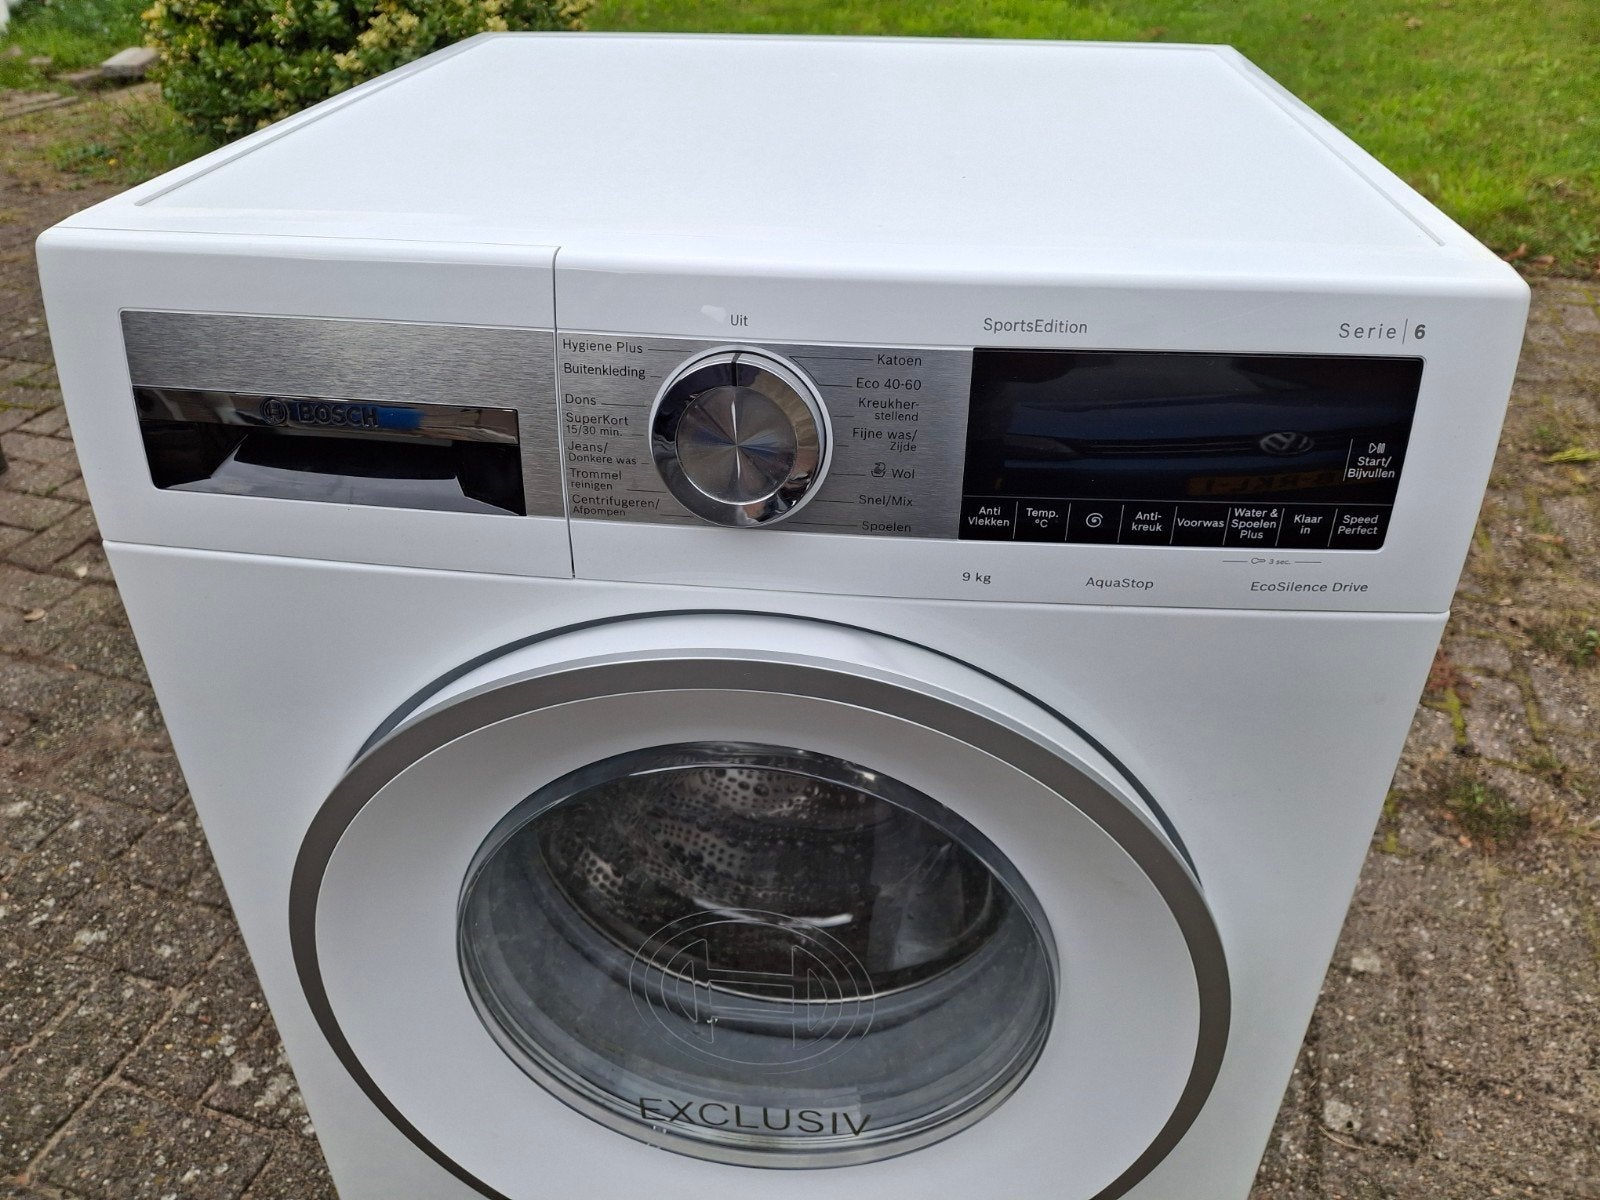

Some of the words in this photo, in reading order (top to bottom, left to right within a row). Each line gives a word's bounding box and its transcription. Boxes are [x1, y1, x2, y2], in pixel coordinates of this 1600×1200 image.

[730, 314, 749, 327] Uit
[983, 317, 1088, 334] SportsEdition
[1338, 322, 1397, 340] Serie
[1414, 323, 1426, 340] 6
[562, 338, 613, 352] Hygiene
[616, 341, 643, 354] Plus
[877, 353, 922, 367] Katoen
[563, 362, 646, 380] Buitenkleding
[856, 377, 880, 389] Eco
[884, 378, 922, 391] 40-60
[565, 393, 597, 406] Dons
[858, 397, 920, 411] Kreukher-
[297, 401, 380, 429] BOSCH
[566, 412, 629, 426] SuperKort
[874, 411, 919, 422] stellend
[566, 424, 596, 436] 15/30
[599, 426, 623, 437] min.
[852, 427, 883, 441] Fijne
[887, 429, 918, 442] was/
[567, 441, 609, 454] Jeans/
[889, 441, 917, 453] Zijde
[568, 452, 613, 464] Donkere
[616, 456, 637, 465] was
[1357, 455, 1393, 468] Start/
[569, 467, 622, 481] Trommel
[891, 468, 915, 479] Wol
[1347, 468, 1396, 480] Bijvullen
[571, 480, 613, 492] reinigen
[572, 494, 660, 510] Centrifugeren/
[858, 494, 914, 508] Snel/Mix
[573, 505, 626, 517] Afpompen
[978, 506, 1001, 516] Anti
[1026, 507, 1059, 519] Temp.
[1134, 511, 1162, 522] Anti-
[1233, 507, 1268, 518] Water
[1270, 508, 1279, 519] &
[967, 516, 1010, 528] Vlekken
[1177, 517, 1225, 529] Voorwas
[1230, 518, 1277, 531] Spoelen
[1293, 514, 1323, 524] Klaar
[1342, 514, 1379, 526] Speed
[861, 520, 912, 533] Spoelen
[1131, 521, 1163, 533] kreuk
[1299, 525, 1311, 535] in
[1337, 525, 1379, 536] Perfect
[1239, 529, 1264, 540] Plus
[1268, 558, 1275, 566] 3
[1276, 558, 1291, 566] sec.
[961, 571, 971, 582] 9
[975, 572, 992, 586] kg
[1085, 576, 1155, 591] AquaStop
[1250, 581, 1328, 593] EcoSilence
[1331, 581, 1369, 593] Drive
[639, 1097, 872, 1137] EXCLUSIV
